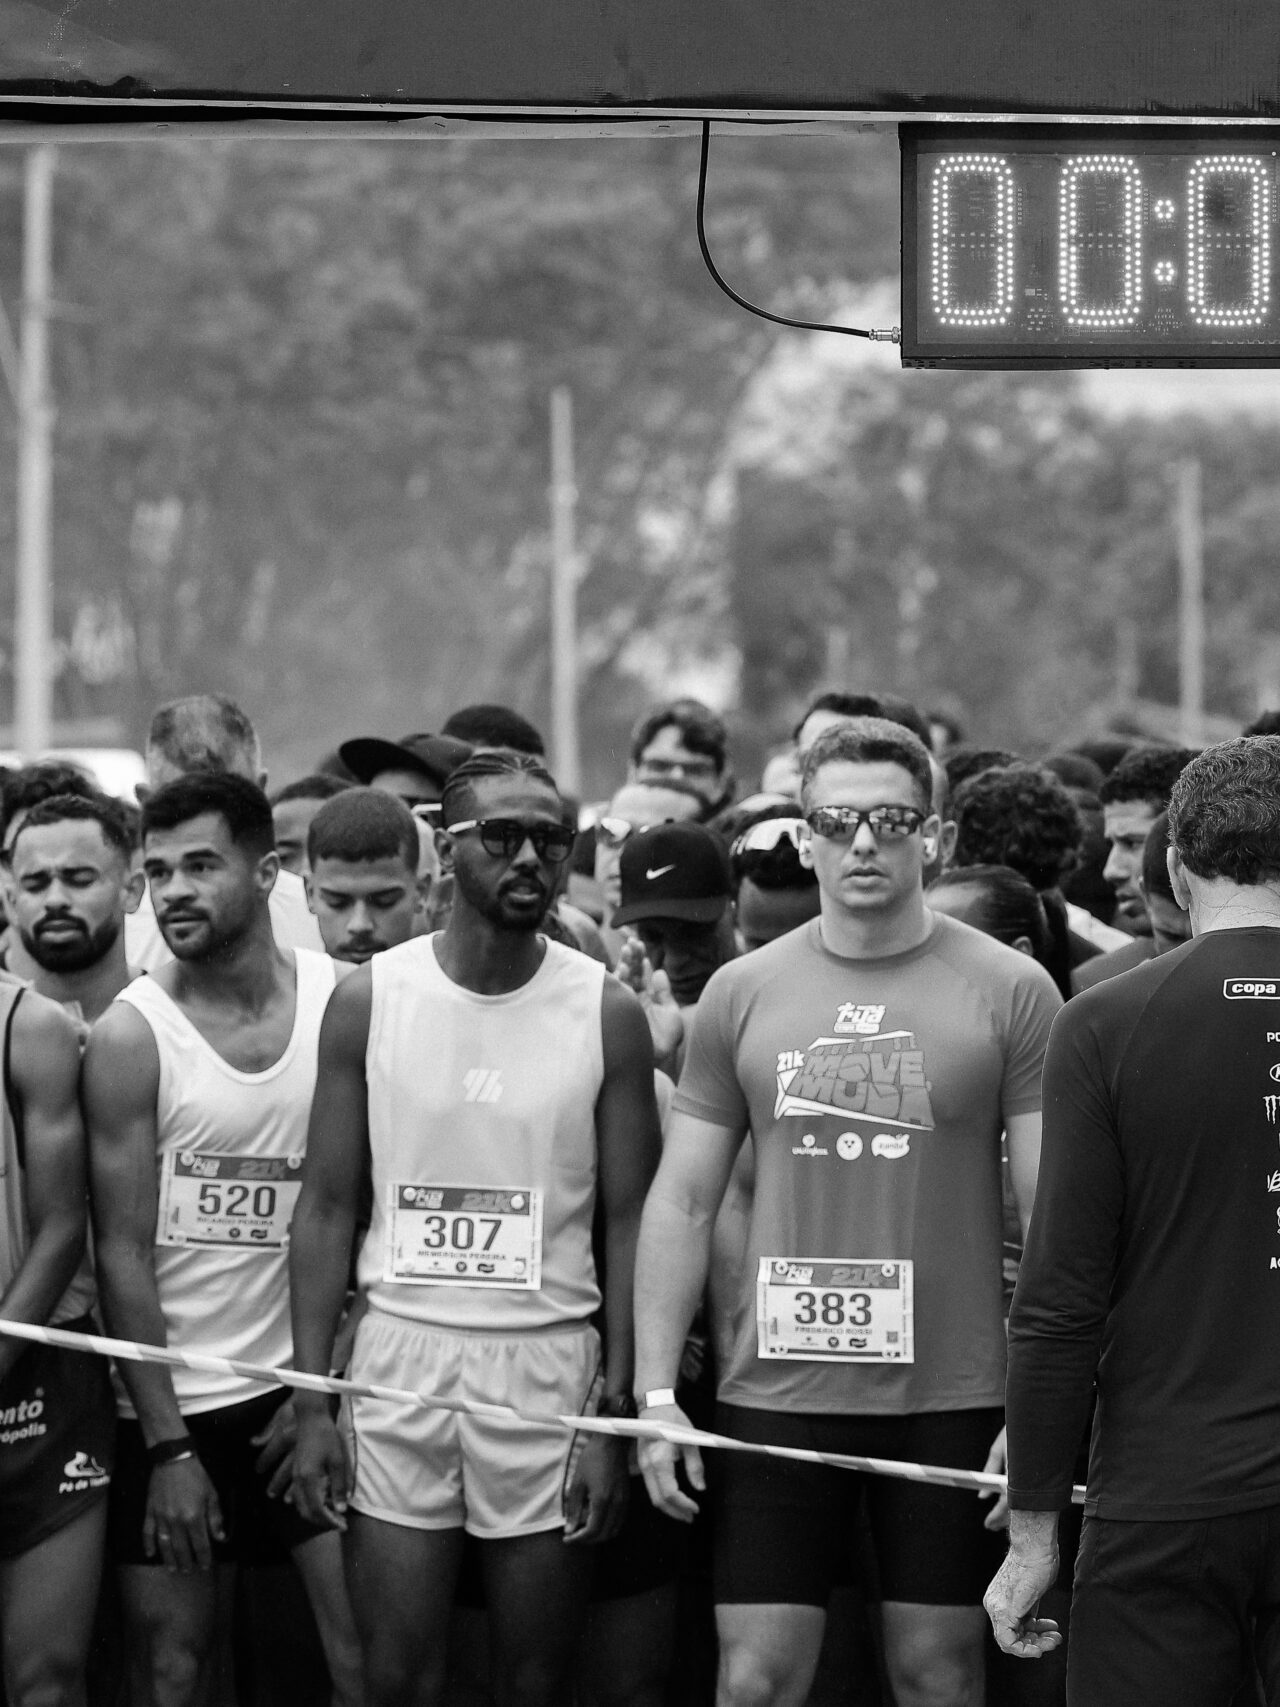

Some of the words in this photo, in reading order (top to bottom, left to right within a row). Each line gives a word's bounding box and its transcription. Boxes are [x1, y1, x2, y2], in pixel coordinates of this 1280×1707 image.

[1231, 983, 1277, 996] copa
[198, 1184, 276, 1217] 520
[424, 1216, 502, 1251] 307
[794, 1291, 872, 1326] 383
